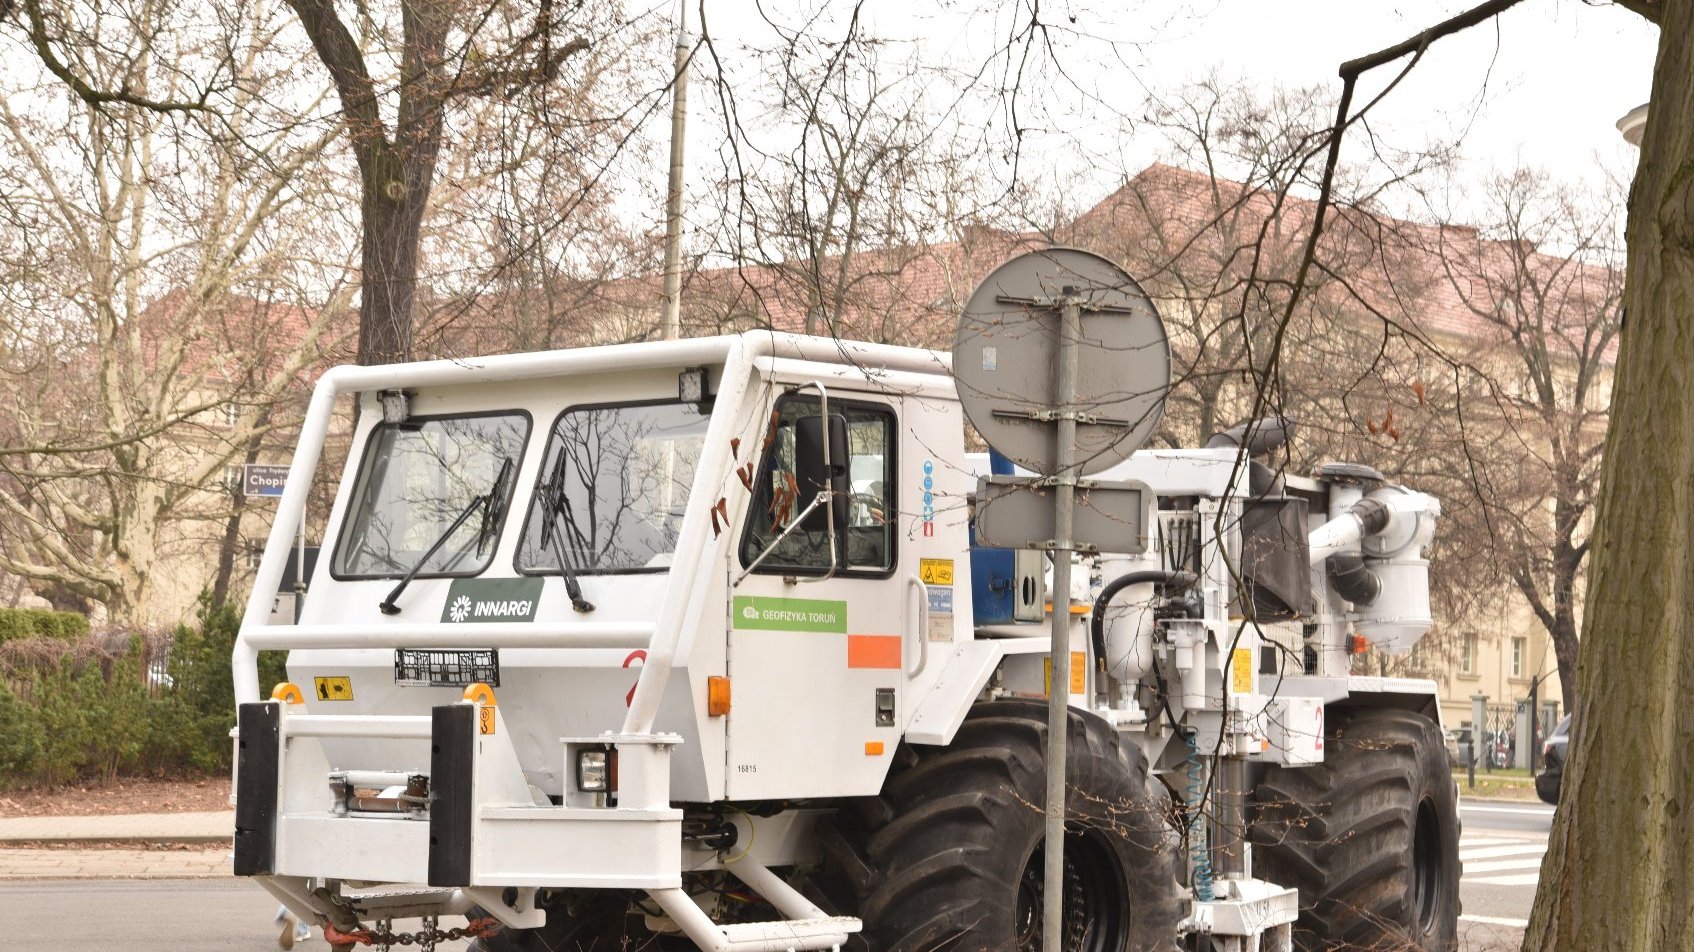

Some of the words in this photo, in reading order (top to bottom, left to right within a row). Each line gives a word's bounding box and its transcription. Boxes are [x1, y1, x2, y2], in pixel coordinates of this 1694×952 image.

[474, 600, 533, 617] INNARGI
[763, 609, 807, 622] GEOFIZYKA
[808, 611, 836, 624] TORUŃ
[1315, 706, 1323, 751] 2
